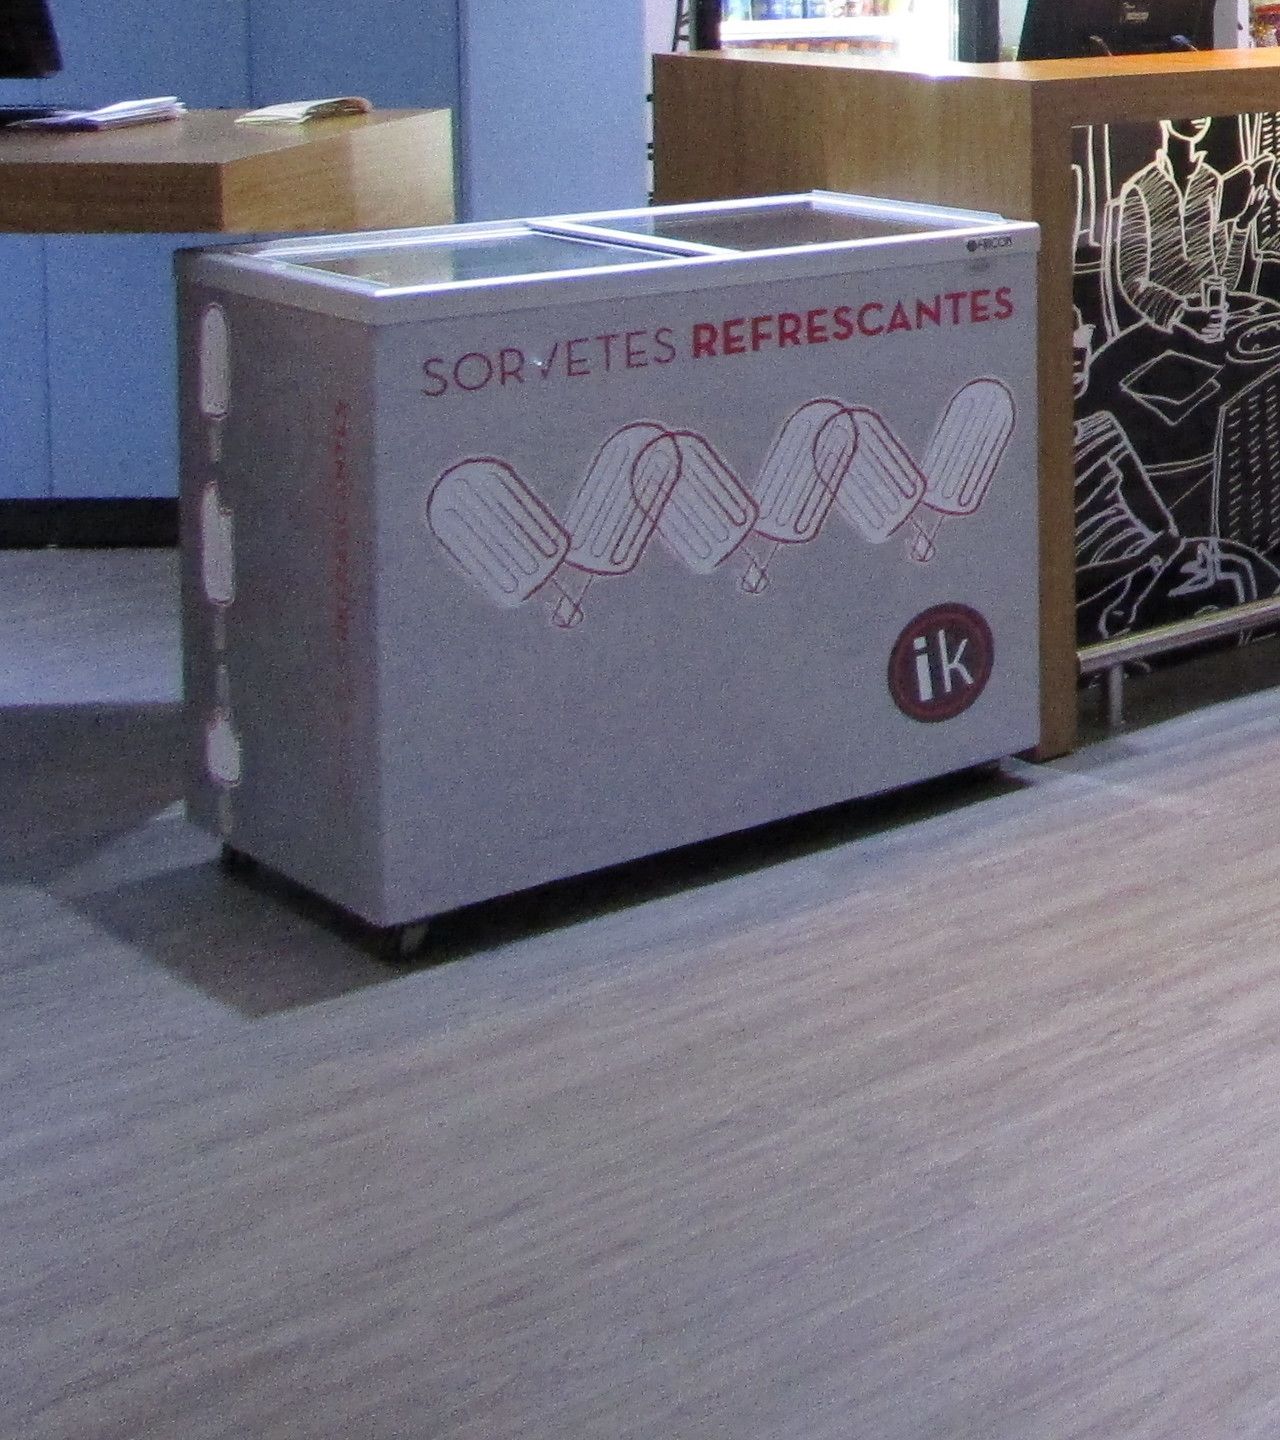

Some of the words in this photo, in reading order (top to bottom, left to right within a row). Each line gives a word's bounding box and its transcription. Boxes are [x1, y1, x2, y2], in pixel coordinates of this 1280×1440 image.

[422, 327, 677, 397] SORVETES
[691, 287, 1014, 360] REFRESCANTES
[913, 629, 974, 702] ik
